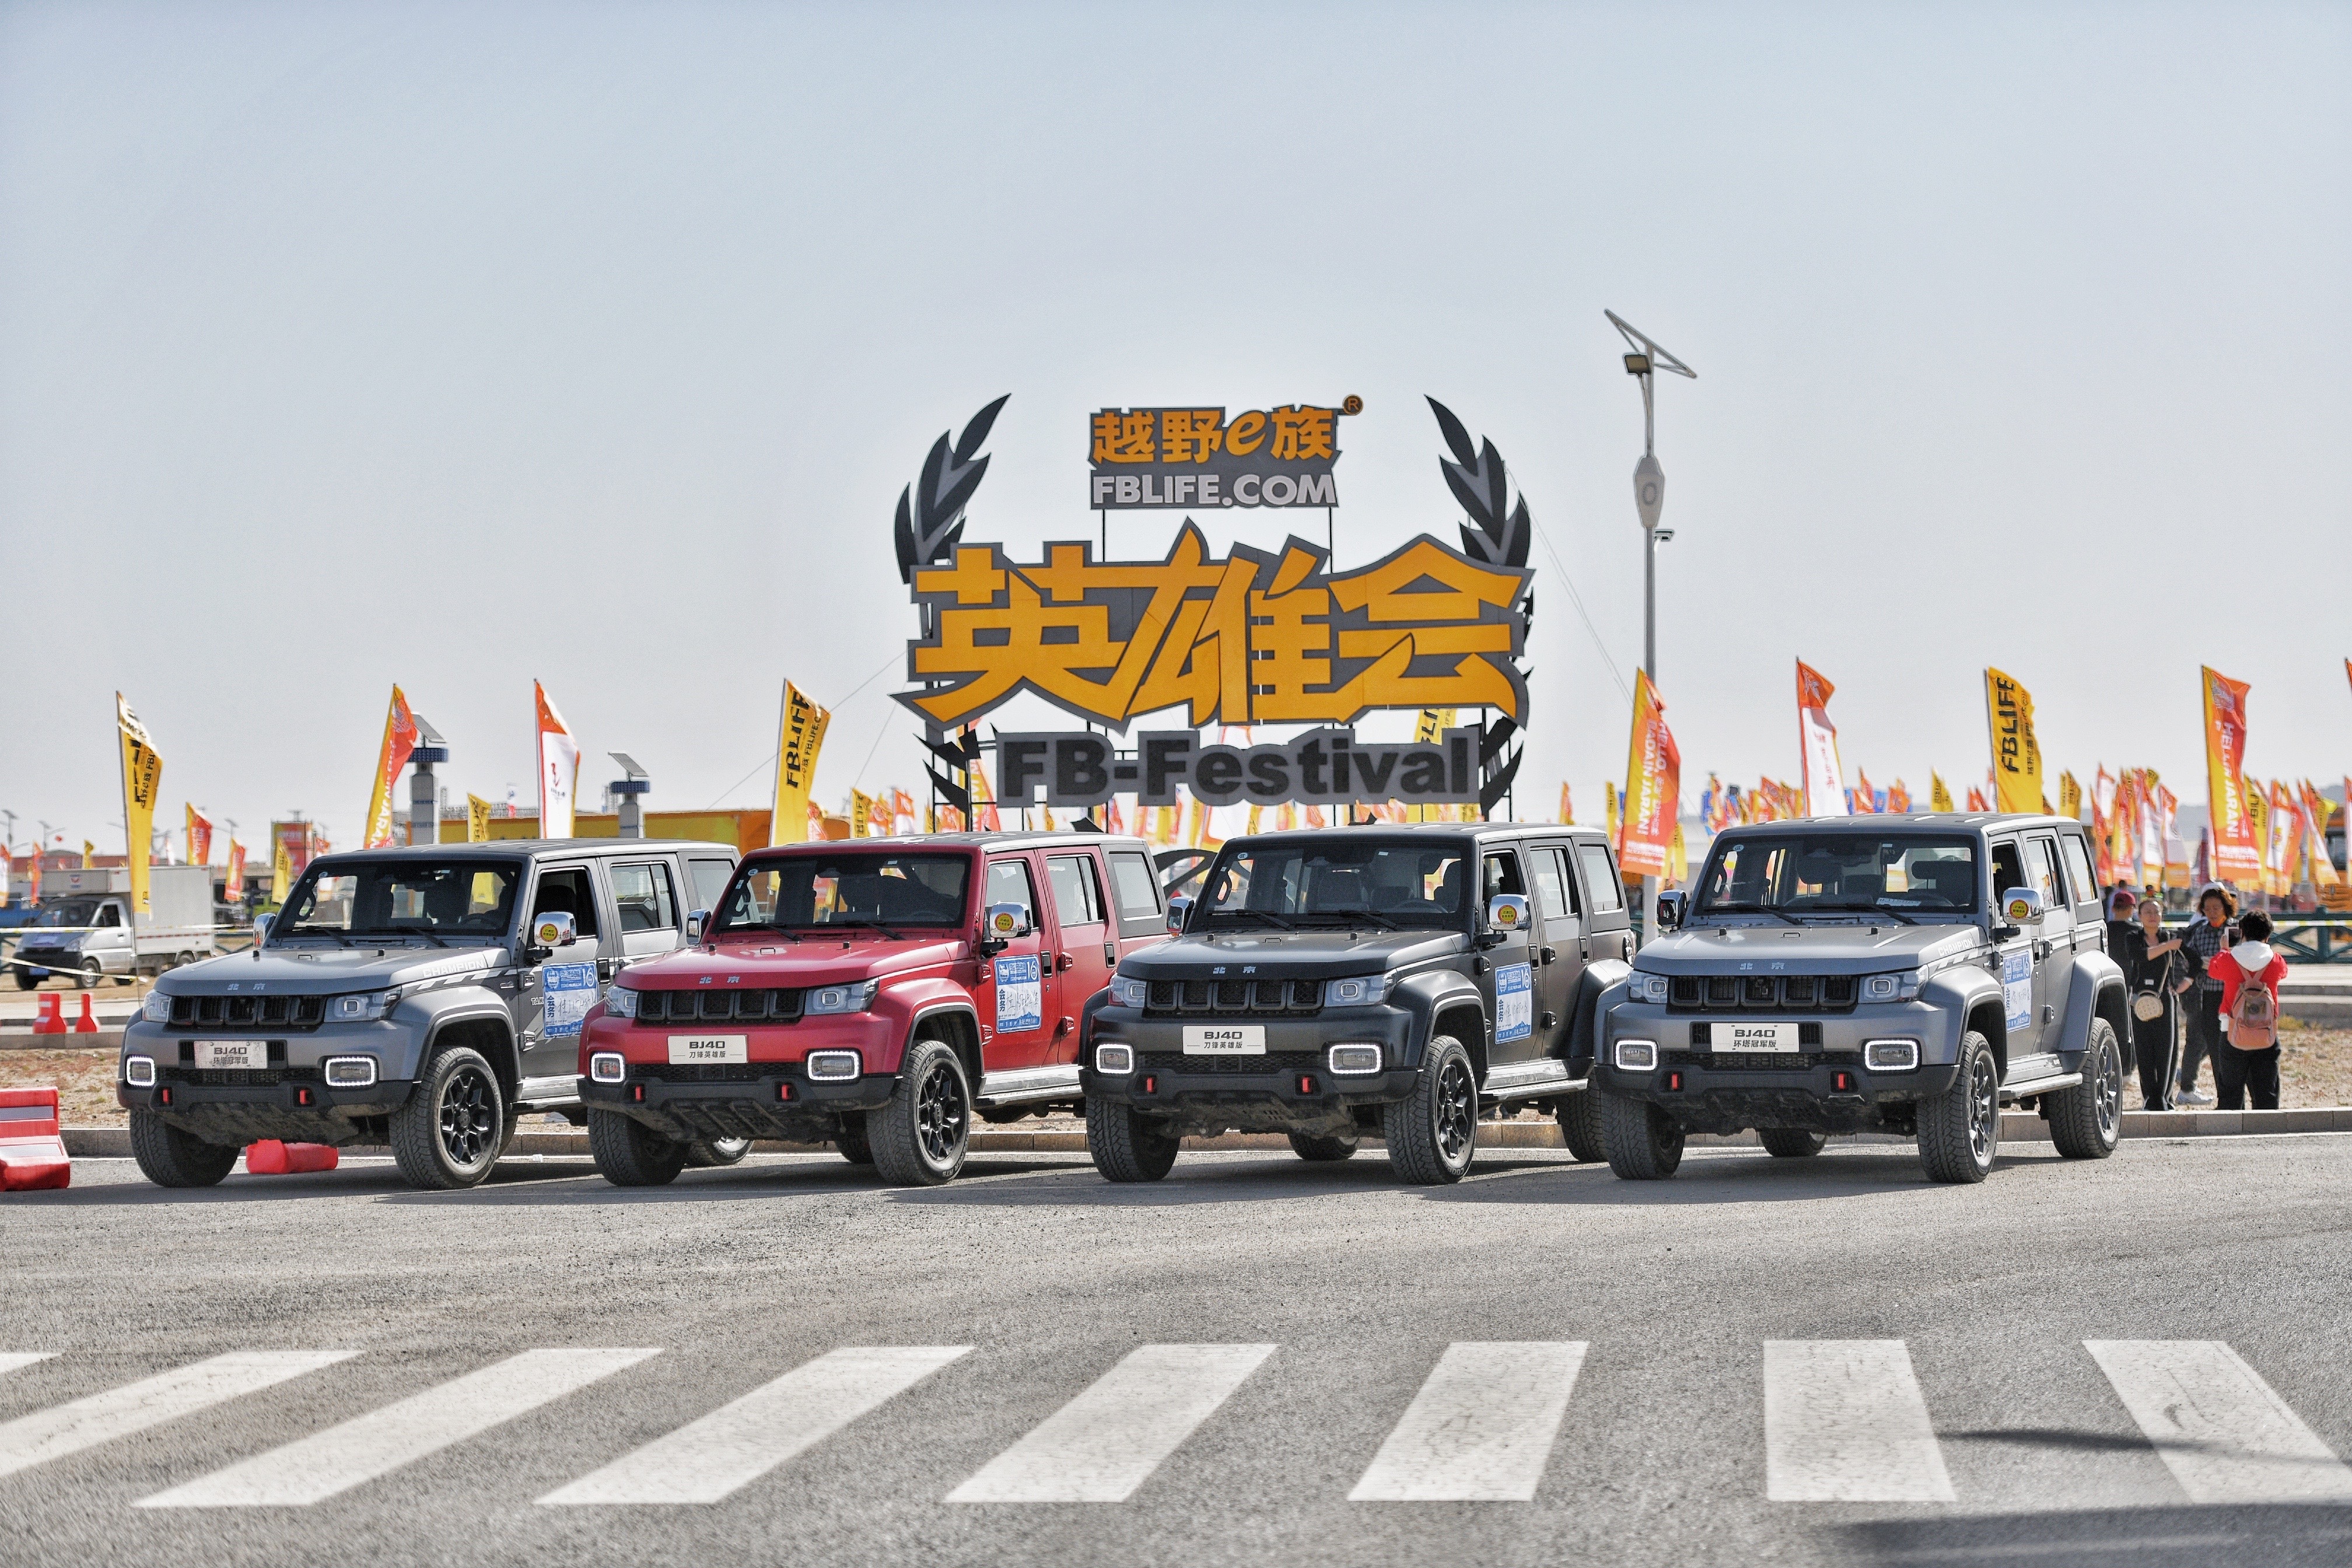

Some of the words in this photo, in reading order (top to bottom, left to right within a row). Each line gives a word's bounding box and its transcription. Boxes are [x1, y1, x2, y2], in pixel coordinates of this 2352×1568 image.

[1093, 407, 1334, 464] 越野e族
[1094, 474, 1335, 506] FBLIFE.COM
[912, 523, 1522, 725] 英雄会
[1996, 676, 2020, 773] FBLIFE
[785, 690, 810, 789] FBLIFE
[1004, 736, 1468, 797] FB-Festival
[1938, 937, 1973, 957] CHAMPION
[422, 960, 485, 978] CHAMPION
[1204, 1031, 1242, 1040] BJ40
[1734, 1029, 1776, 1038] BJ40
[689, 1041, 726, 1049] BJ40
[1203, 1041, 1242, 1049] 刀锋英雄版
[1733, 1040, 1777, 1048] 环塔冠军版
[213, 1056, 249, 1065] 环塔冠军版
[688, 1051, 727, 1059] 刀锋英雄版
